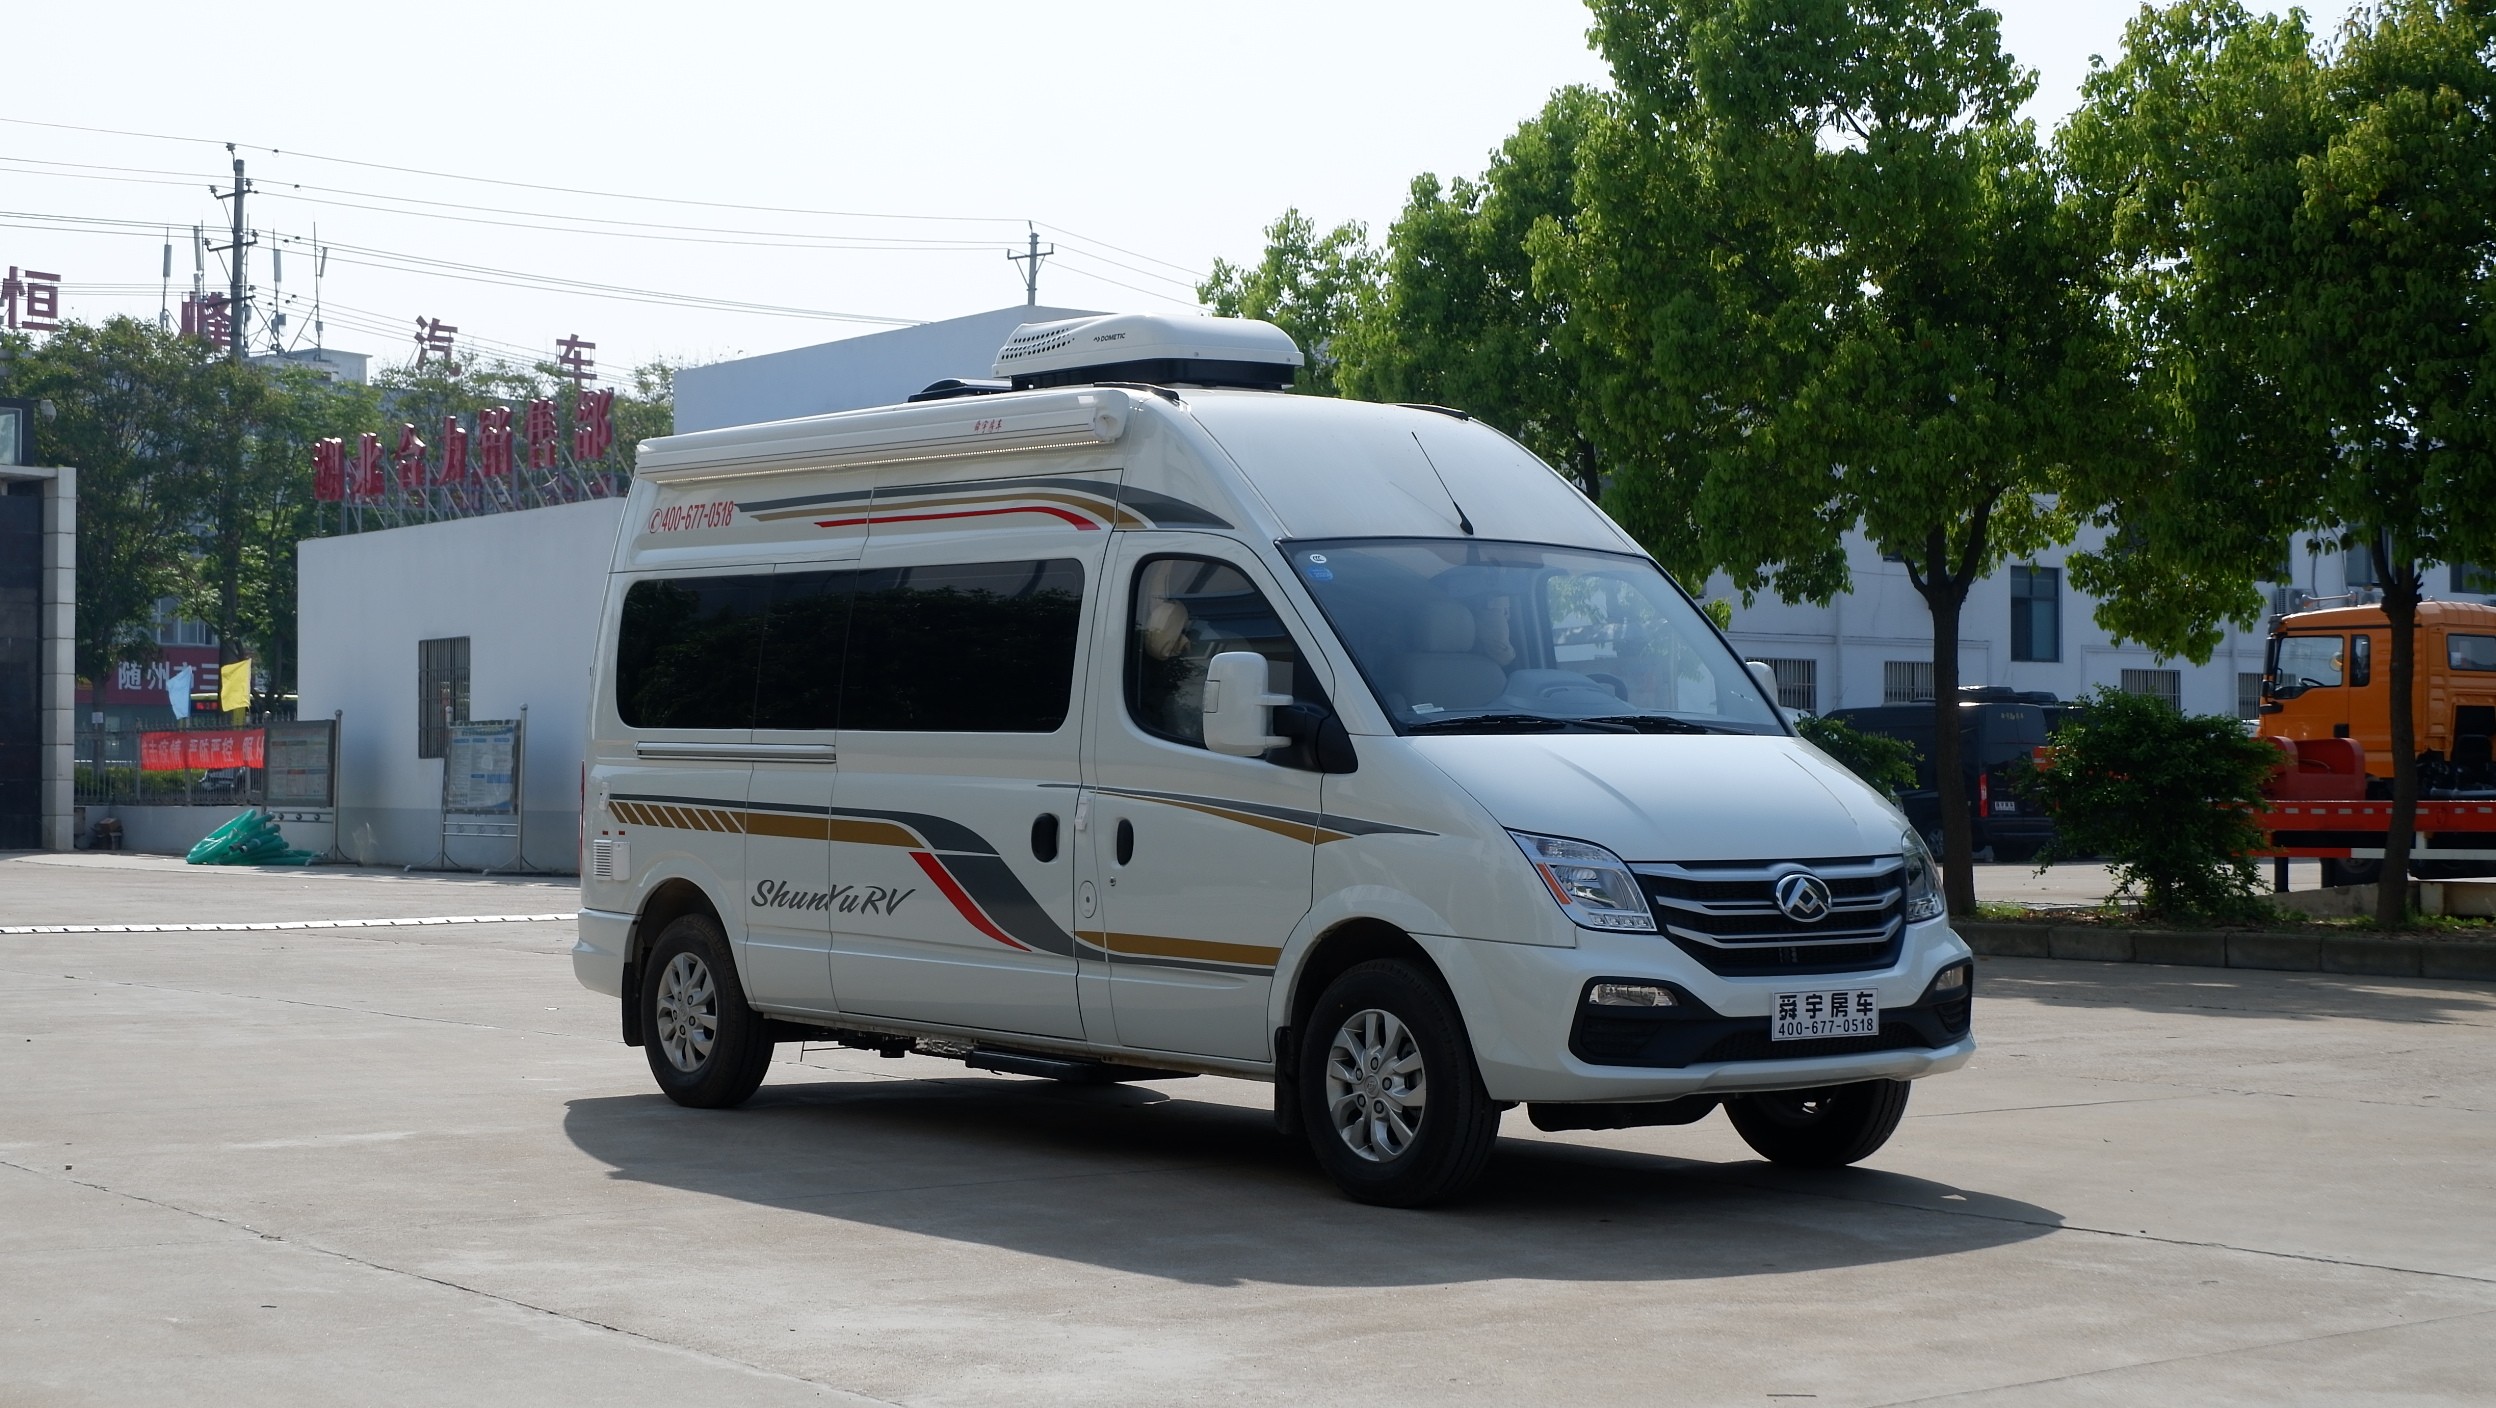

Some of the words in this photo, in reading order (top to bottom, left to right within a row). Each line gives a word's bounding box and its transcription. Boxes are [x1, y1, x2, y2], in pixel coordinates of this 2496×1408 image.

[1101, 333, 1126, 342] DOMETIC
[662, 501, 733, 532] 400-677-0518
[1779, 992, 1873, 1020] 舜宇房车
[1778, 1018, 1873, 1036] 400-677-0518
